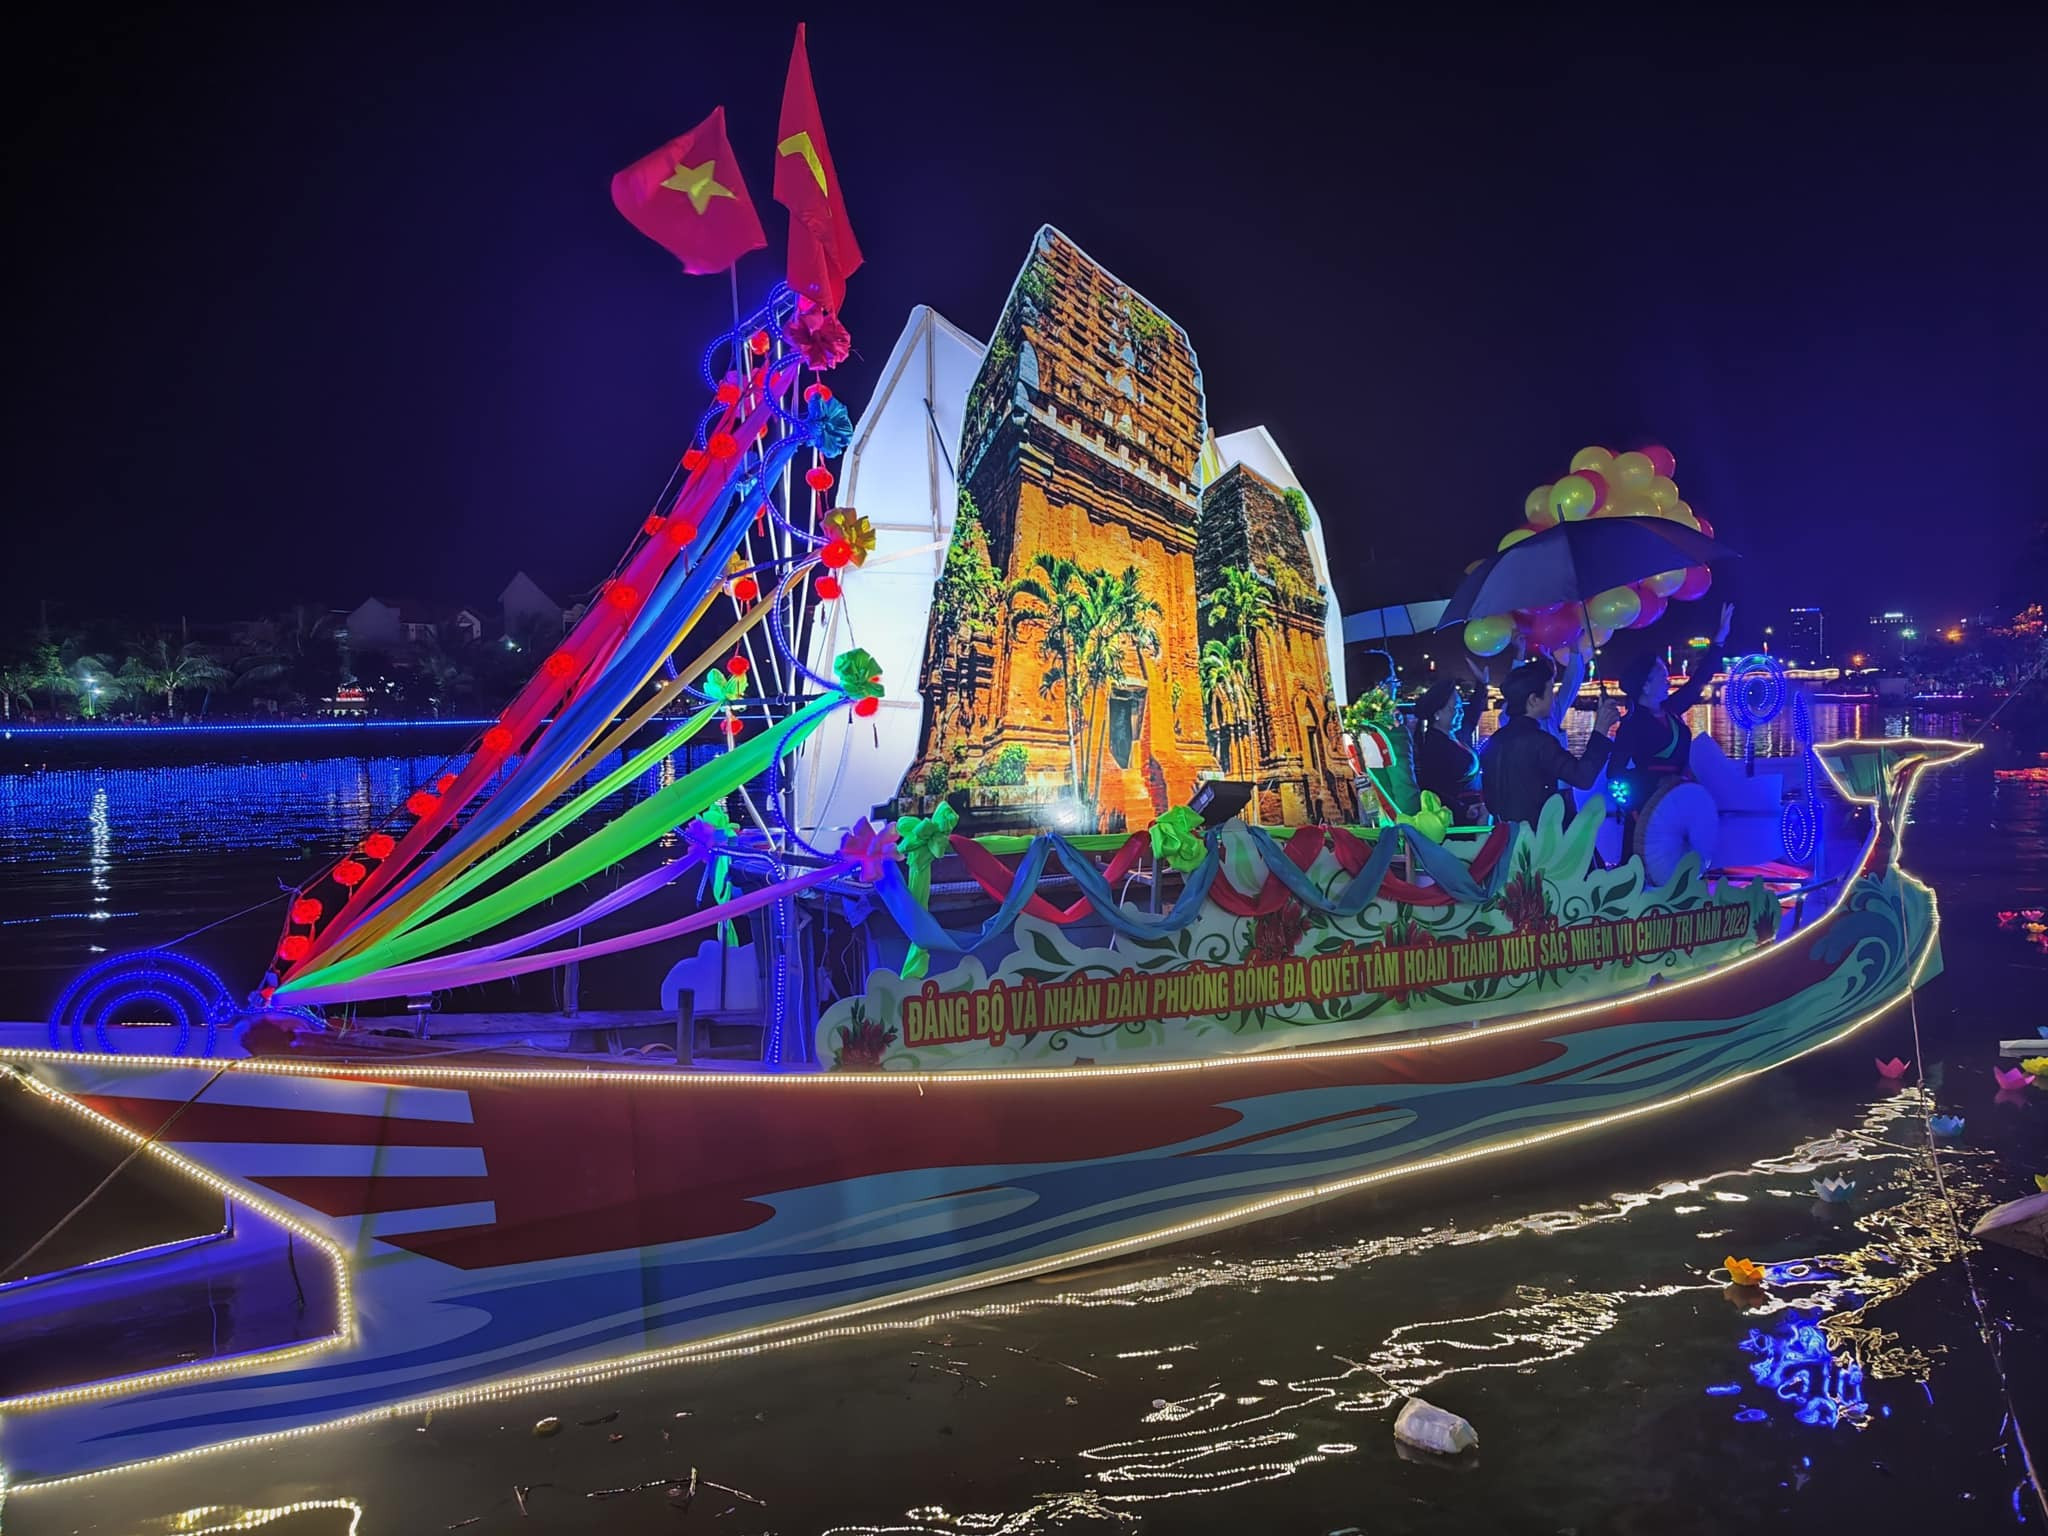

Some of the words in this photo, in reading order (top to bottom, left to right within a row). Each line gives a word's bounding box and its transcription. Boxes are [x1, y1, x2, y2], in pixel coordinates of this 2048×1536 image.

[908, 986, 970, 1042] ĐẢNG
[976, 985, 1005, 1040] BỘ
[1011, 983, 1038, 1030] VÀ
[1044, 977, 1101, 1026] NHÂN
[1106, 974, 1147, 1018] DÂN
[1153, 966, 1229, 1014] PHƯỜNG
[1234, 955, 1279, 1006] ĐỐNG
[1284, 963, 1306, 999] ĐA
[1311, 946, 1359, 998] QUYẾT
[1363, 946, 1399, 989] TÂM
[1405, 940, 1447, 984] HOÀN
[1451, 936, 1498, 978] THÀNH
[1502, 924, 1536, 970] XUẤT
[1540, 921, 1568, 965] SẮC
[1571, 922, 1614, 965] NHIỆM
[1617, 922, 1633, 964] VỤ
[1636, 912, 1673, 950] CHÍNH
[1675, 913, 1693, 952] TRỊ
[1696, 907, 1721, 940] NĂM
[1723, 904, 1749, 936] 2023
